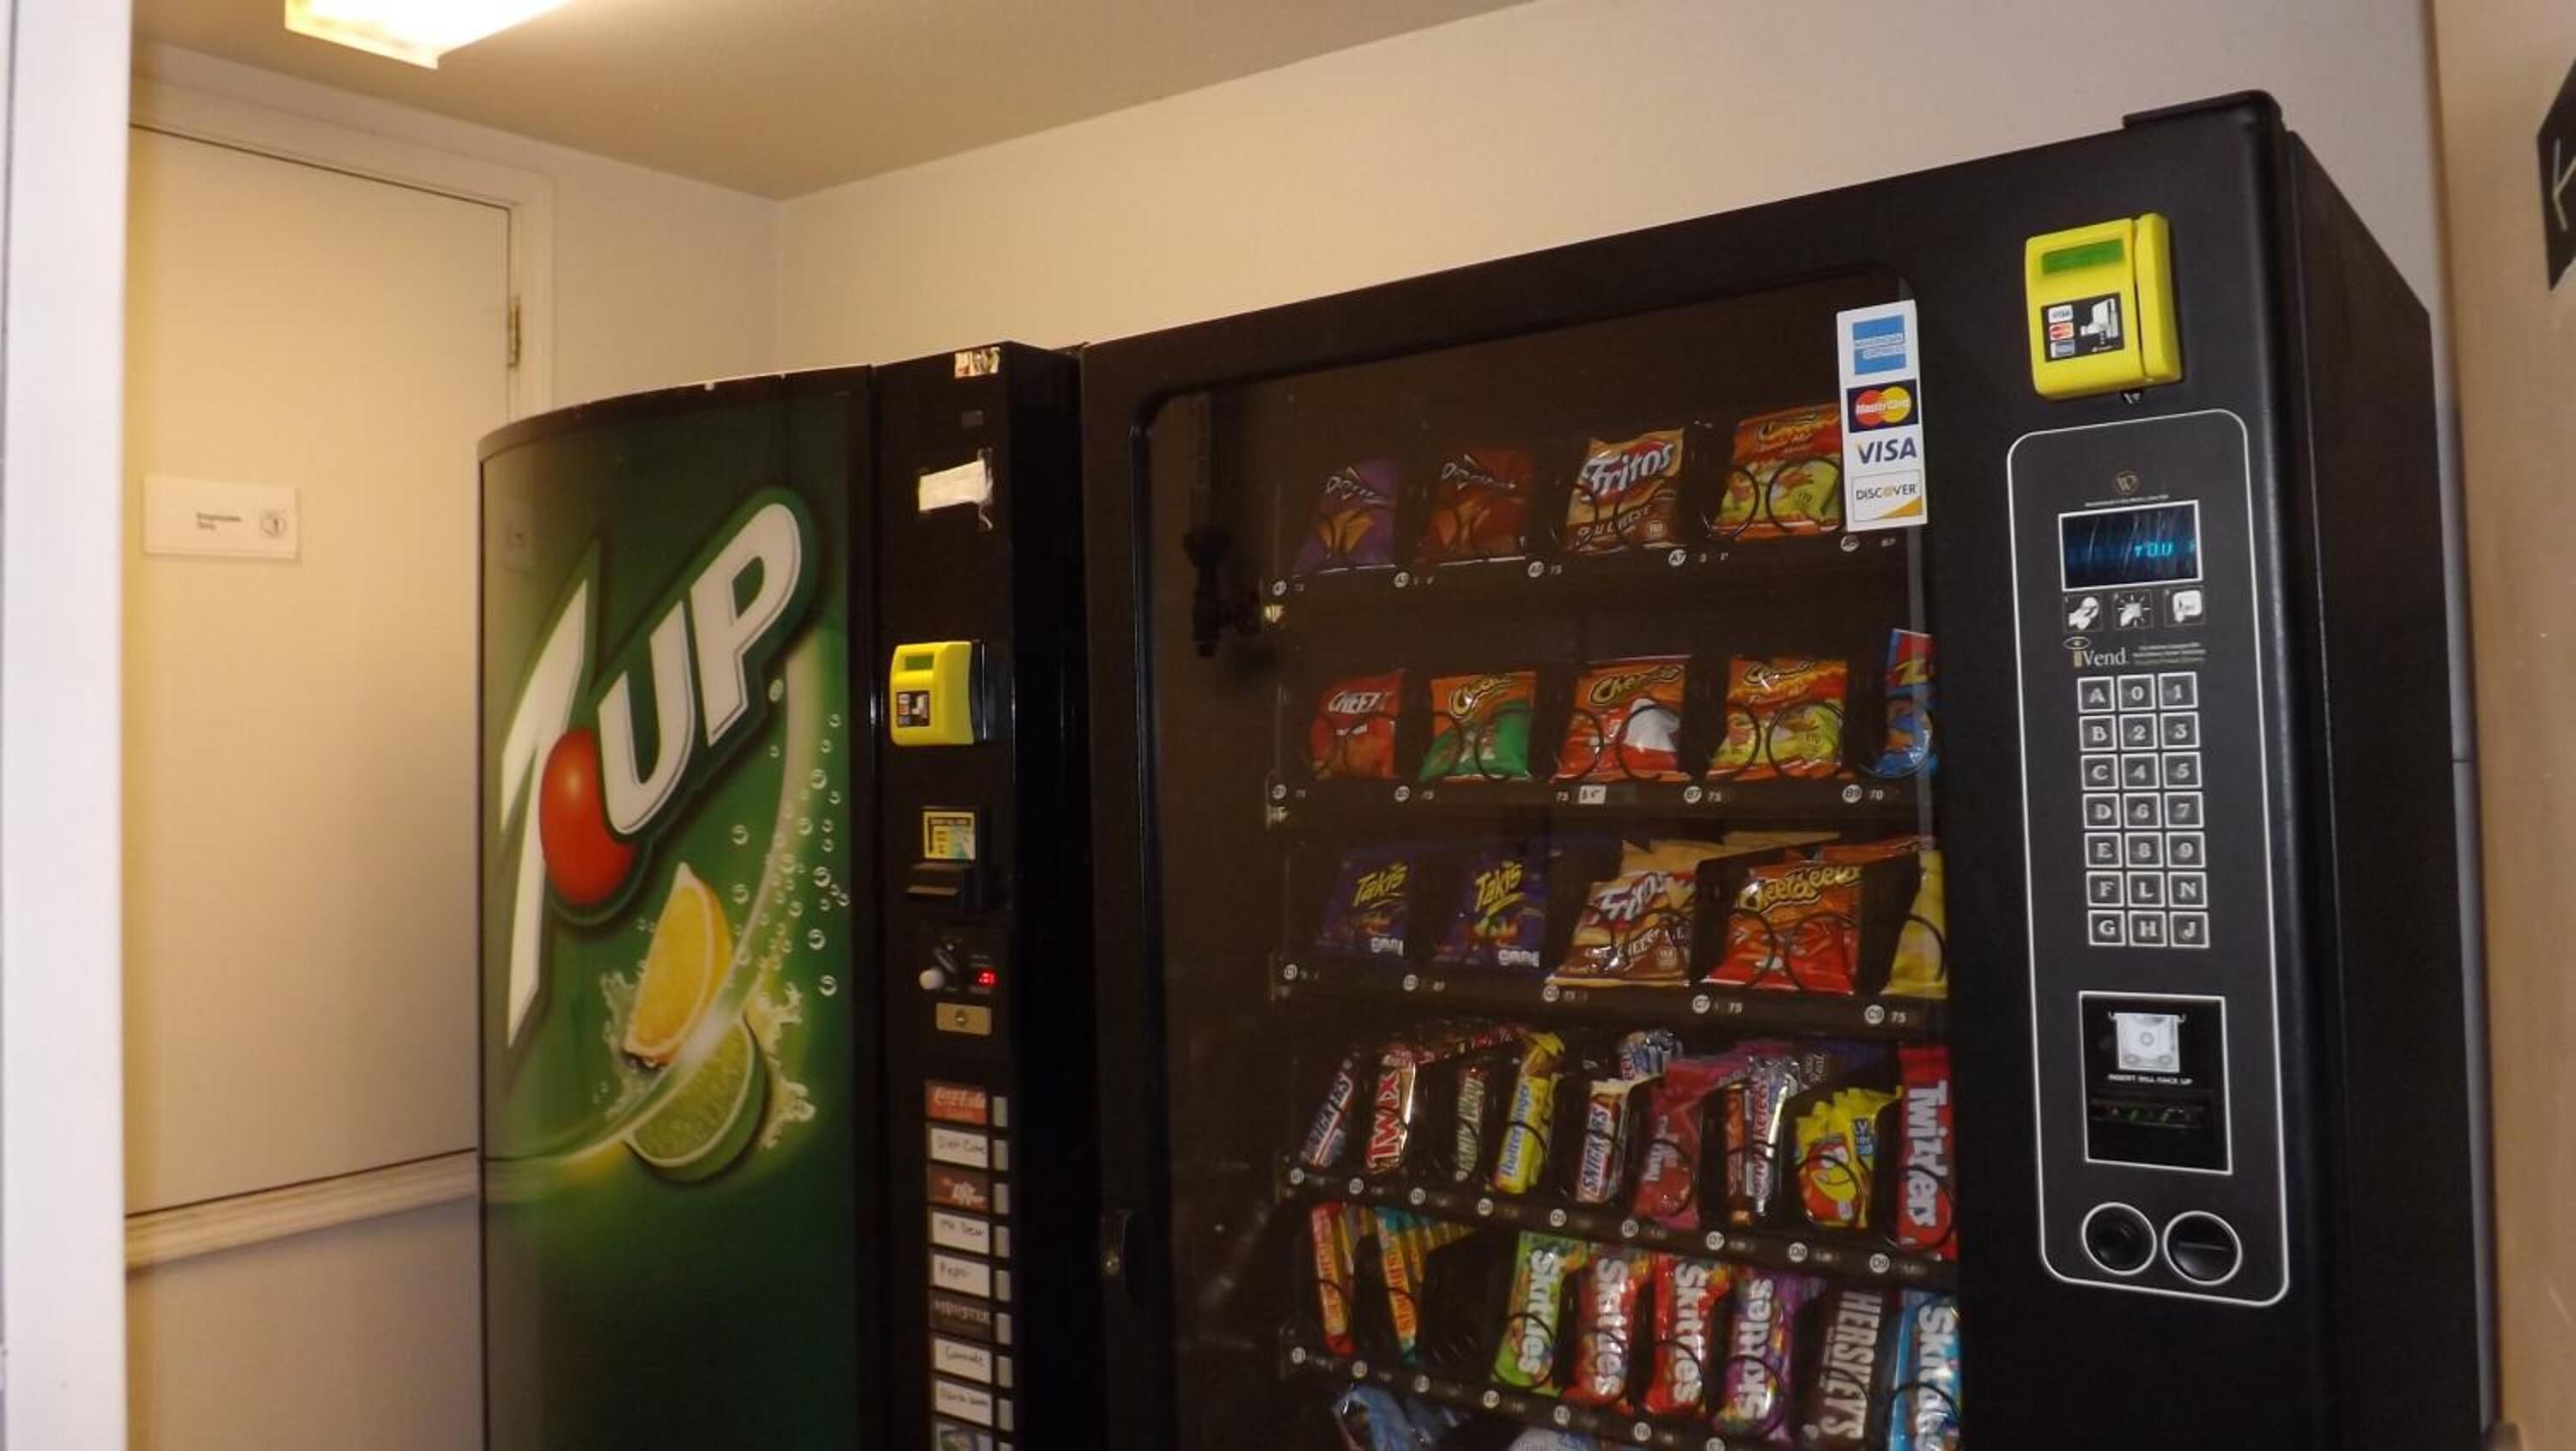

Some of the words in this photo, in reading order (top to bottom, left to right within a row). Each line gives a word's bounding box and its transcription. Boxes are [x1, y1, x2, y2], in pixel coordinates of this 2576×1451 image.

[1856, 437, 1917, 464] VISA
[1587, 443, 1674, 495] Fritos
[1856, 483, 1917, 501] DISCOVER
[2088, 687, 2106, 704] A
[2130, 685, 2144, 701] 0
[2172, 684, 2183, 701] 1
[2091, 726, 2107, 742] B
[2133, 725, 2147, 741] 2
[2174, 724, 2188, 739] 3
[2092, 764, 2110, 780] C
[2129, 763, 2147, 780] 4
[2176, 762, 2190, 779] 5
[2094, 803, 2112, 820] D
[2136, 803, 2150, 819] 6
[2177, 803, 2191, 819] 7
[2095, 842, 2114, 859] E
[2137, 841, 2152, 859] 8
[2178, 841, 2195, 859] 9
[1352, 860, 1409, 908] Takis
[1473, 859, 1522, 912] Takis
[2099, 880, 2116, 898] F
[2138, 881, 2155, 899] L
[2179, 881, 2196, 898] N
[2099, 919, 2117, 935] G
[2139, 920, 2158, 937] H
[2184, 921, 2196, 938] J
[1371, 1070, 1401, 1169] TWIX
[1517, 1249, 1559, 1374] Skittles
[1674, 1263, 1706, 1403] Skittles
[1737, 1278, 1775, 1420] Skittles
